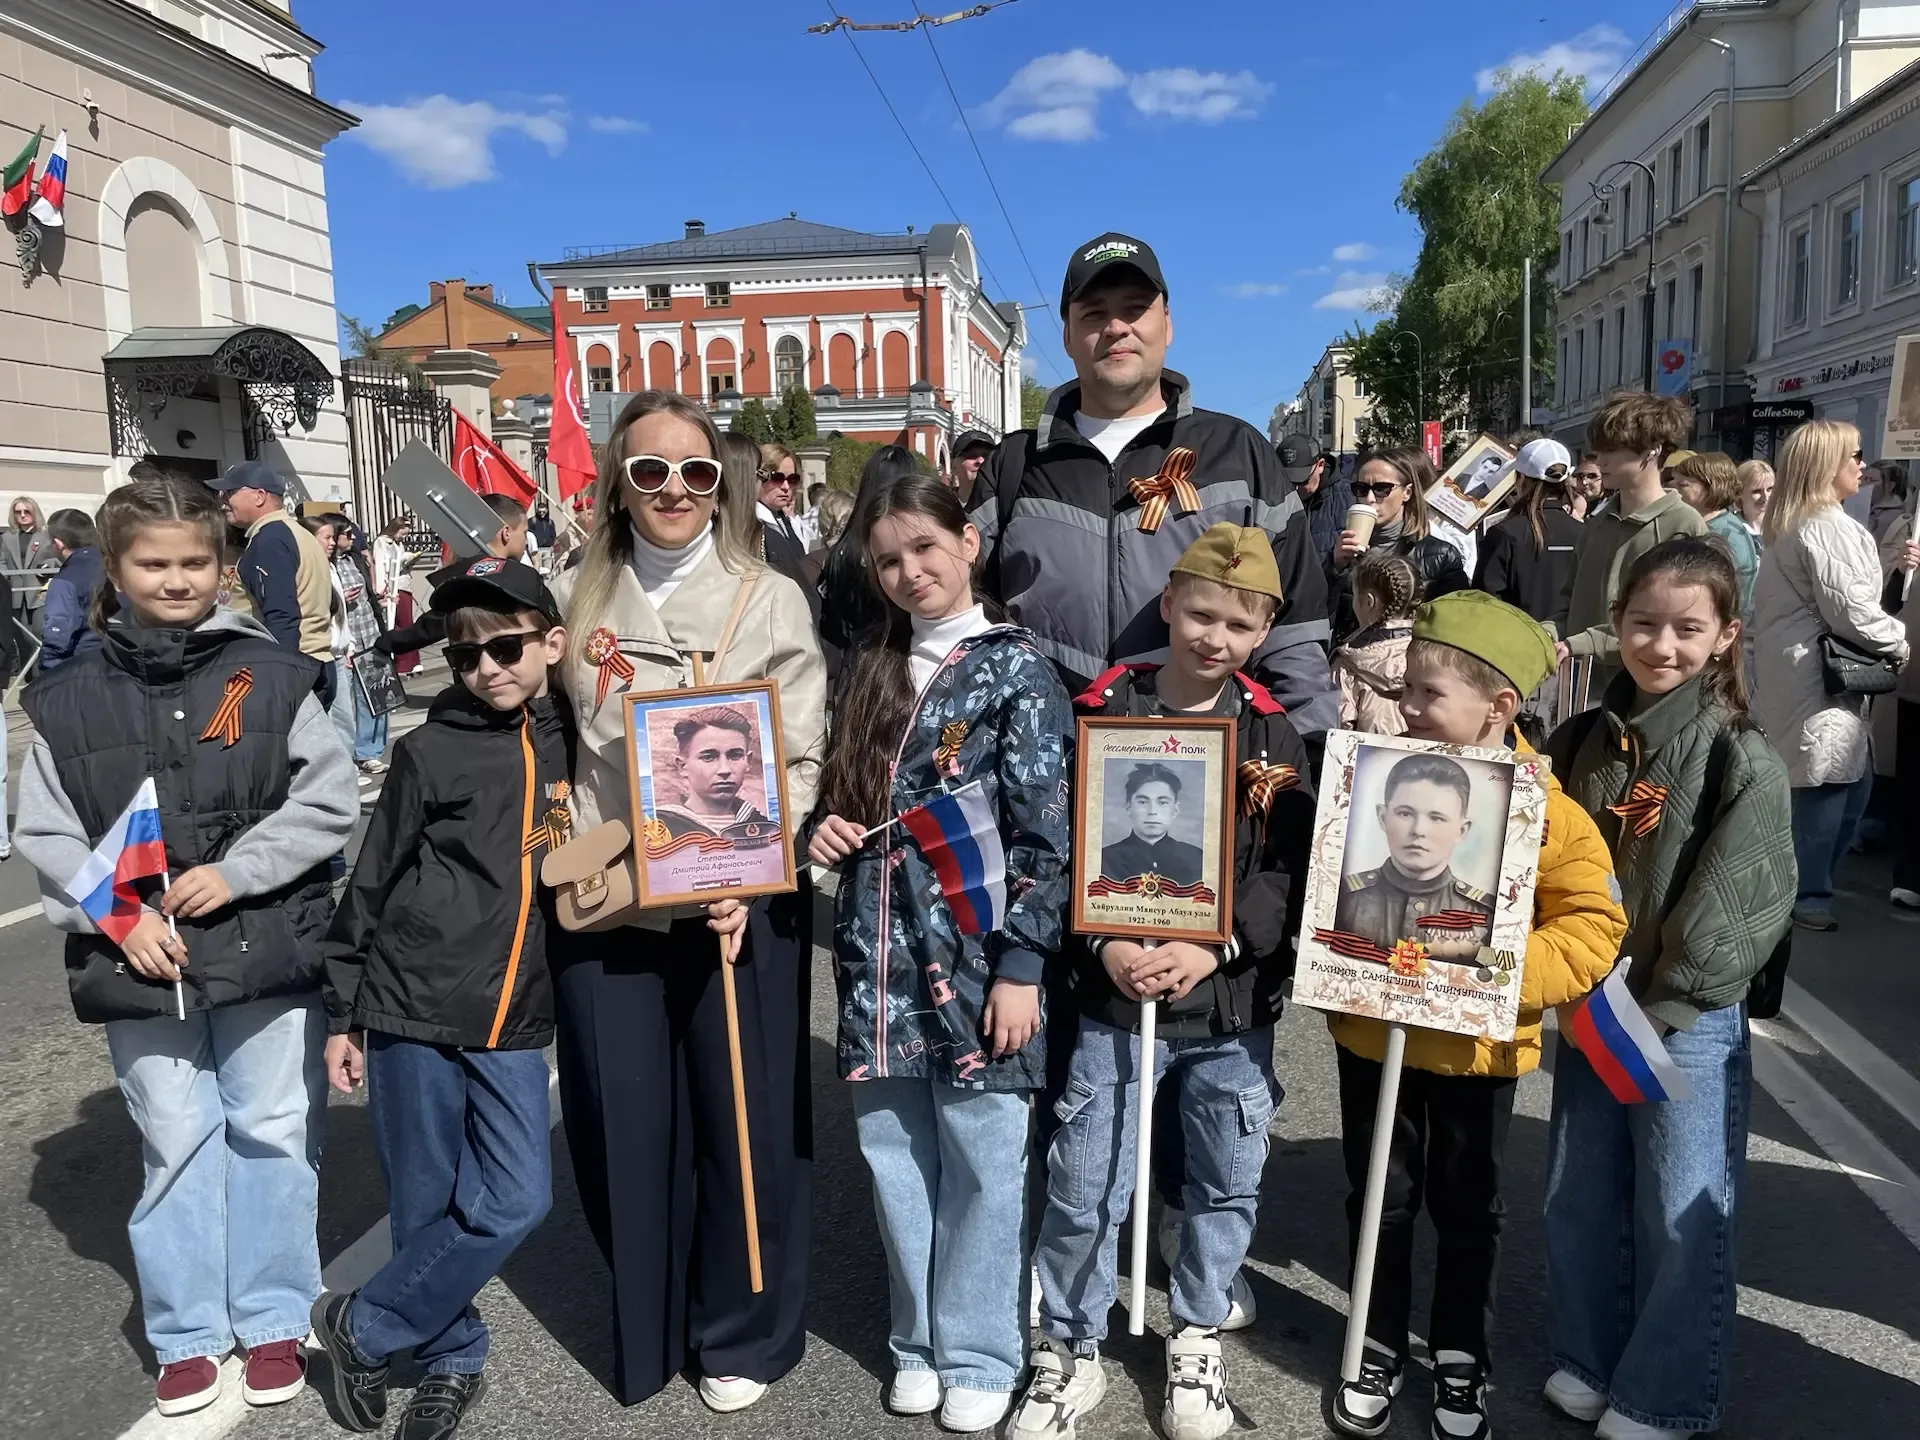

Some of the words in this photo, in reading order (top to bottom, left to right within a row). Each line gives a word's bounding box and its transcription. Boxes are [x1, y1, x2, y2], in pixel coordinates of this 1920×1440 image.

[1753, 405, 1805, 418] CoffeeShop
[697, 854, 736, 863] Степанов
[672, 864, 710, 876] Дмитрий
[711, 859, 762, 871] Афанасьевич
[1091, 902, 1134, 913] Хайруллин
[1136, 905, 1166, 916] Мансур
[1128, 916, 1145, 924] 1922
[1153, 918, 1171, 926] 1960
